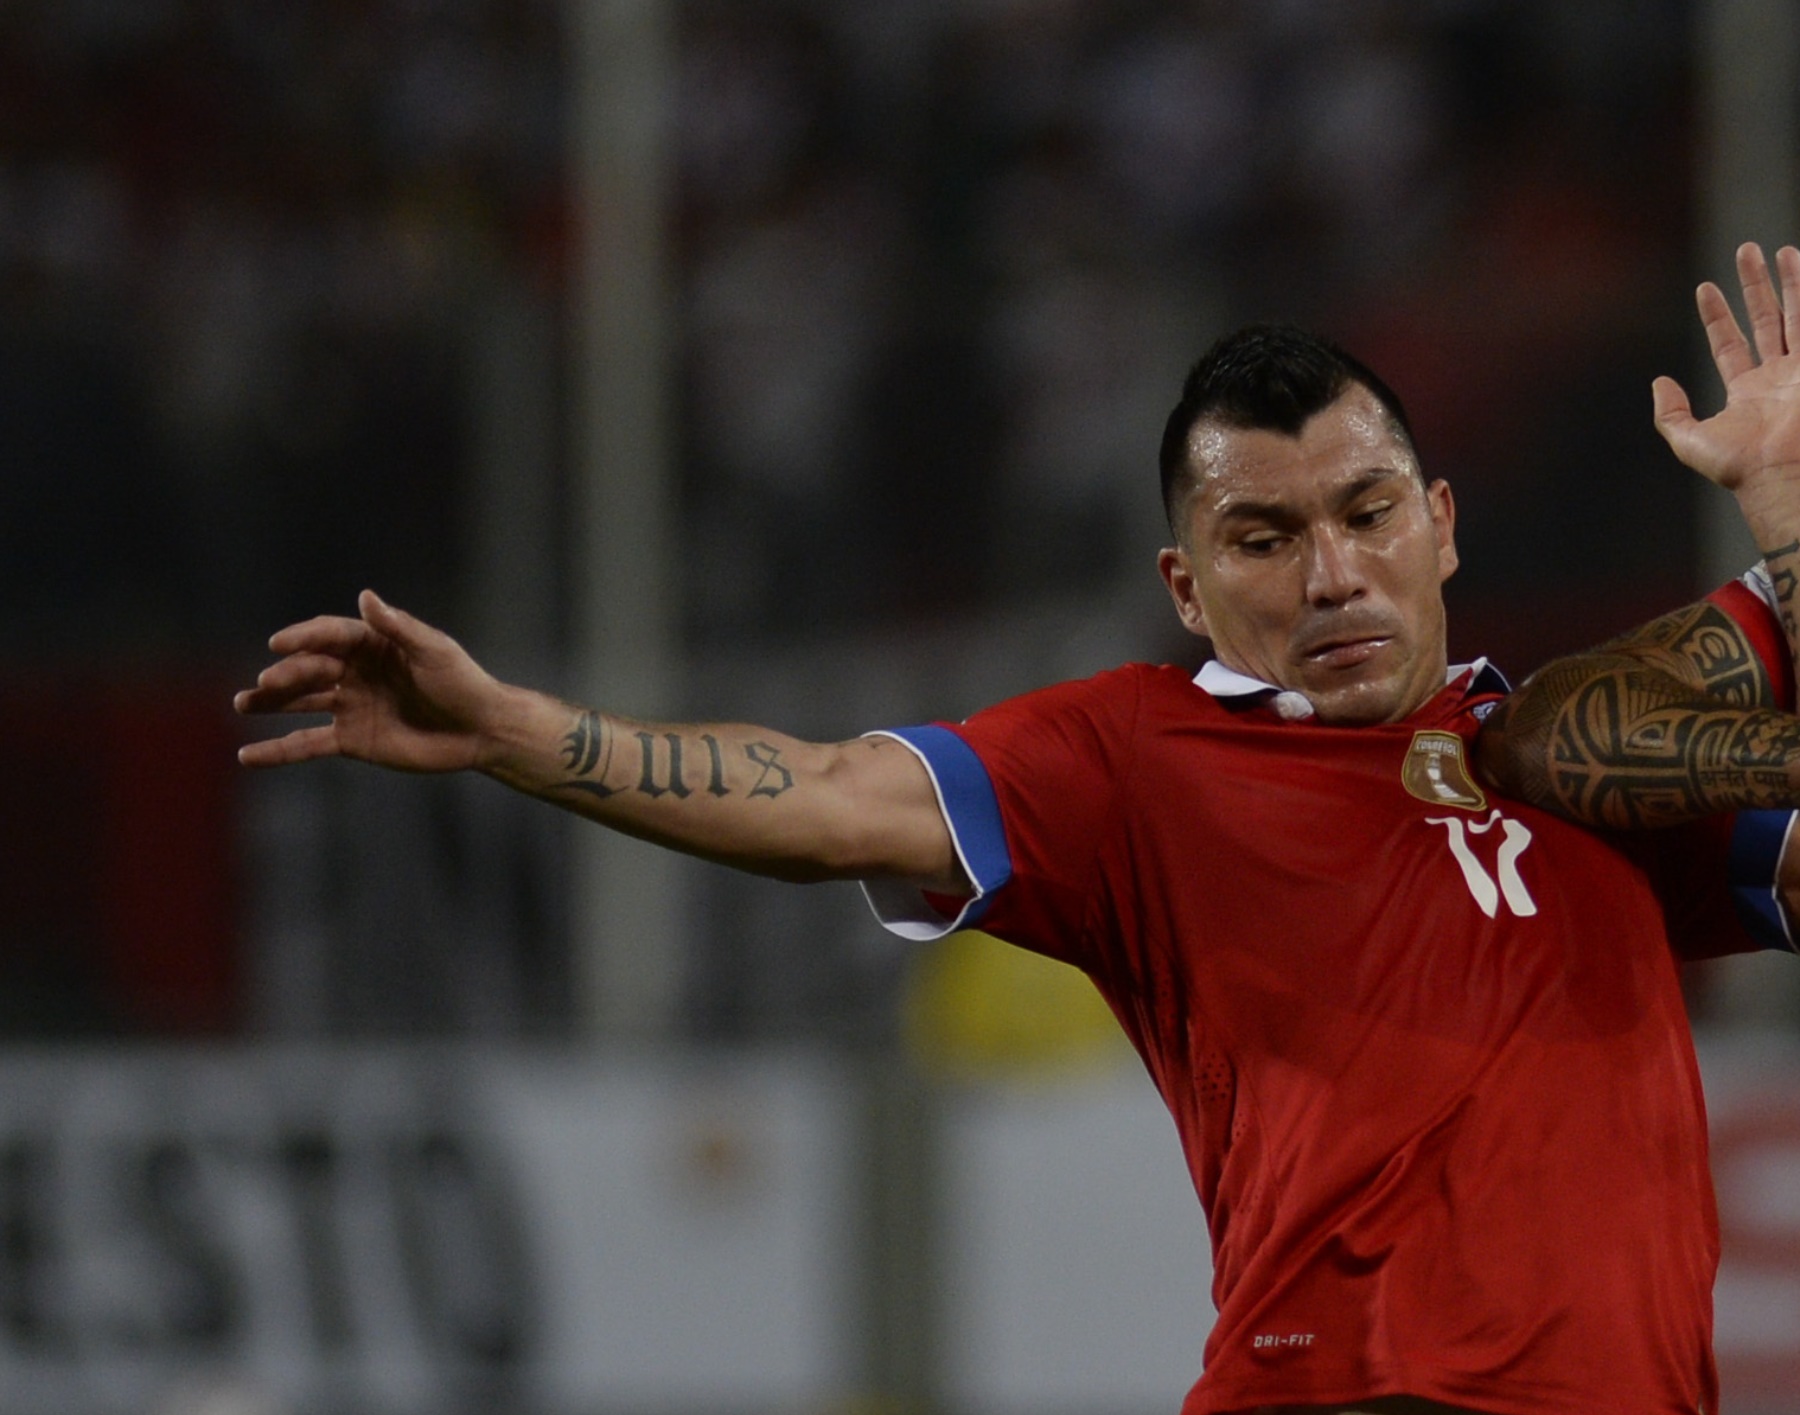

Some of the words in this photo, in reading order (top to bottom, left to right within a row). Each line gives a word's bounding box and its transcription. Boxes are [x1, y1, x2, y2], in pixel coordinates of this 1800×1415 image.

[548, 710, 795, 800] Luis
[1425, 808, 1538, 919] 17
[1254, 1334, 1315, 1347] DRI-FIT
